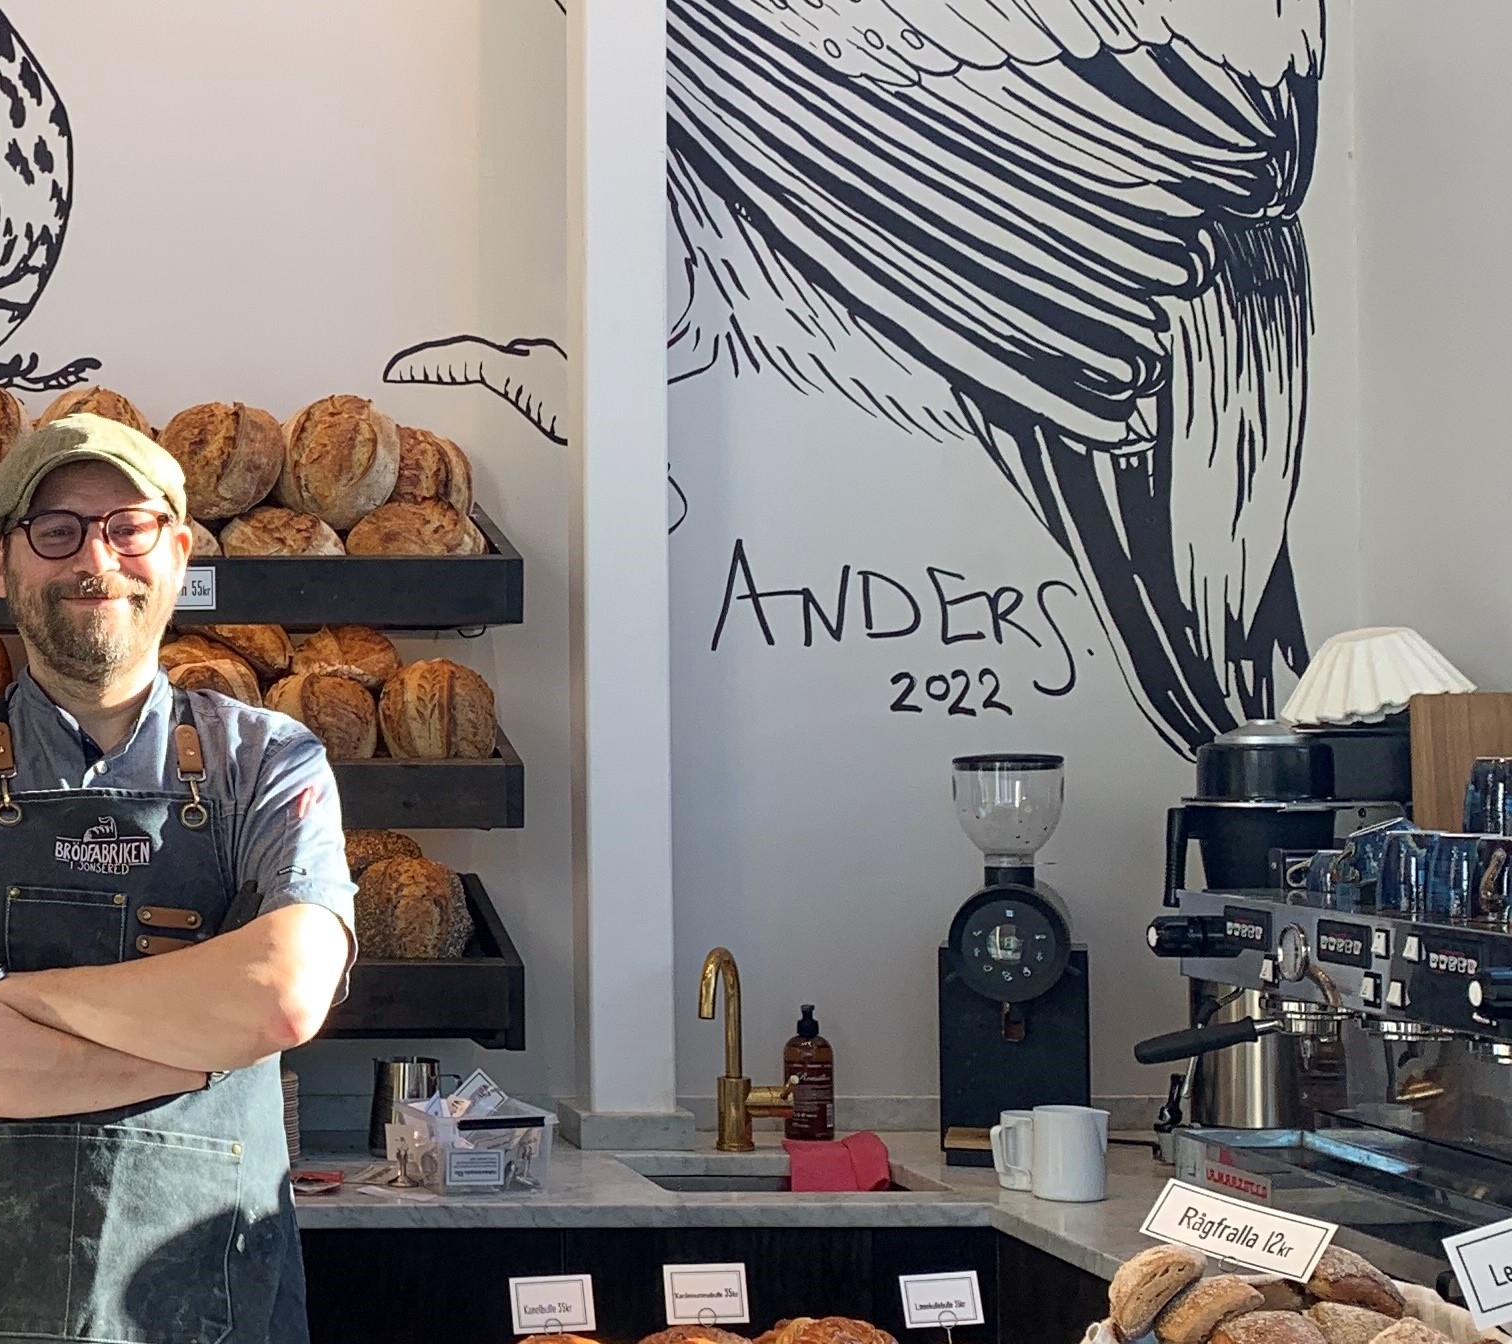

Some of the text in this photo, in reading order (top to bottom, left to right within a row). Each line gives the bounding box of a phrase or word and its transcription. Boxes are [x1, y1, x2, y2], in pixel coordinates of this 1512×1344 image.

[191, 579, 211, 597] 55kr
[889, 667, 1013, 717] 2022
[54, 840, 151, 865] BRÖDFABRIKEN
[77, 860, 130, 876] JONSERED
[1177, 1205, 1295, 1259] Rågfralla 12kr
[1488, 1263, 1512, 1287] Le
[523, 1304, 557, 1315] Kanelbulle
